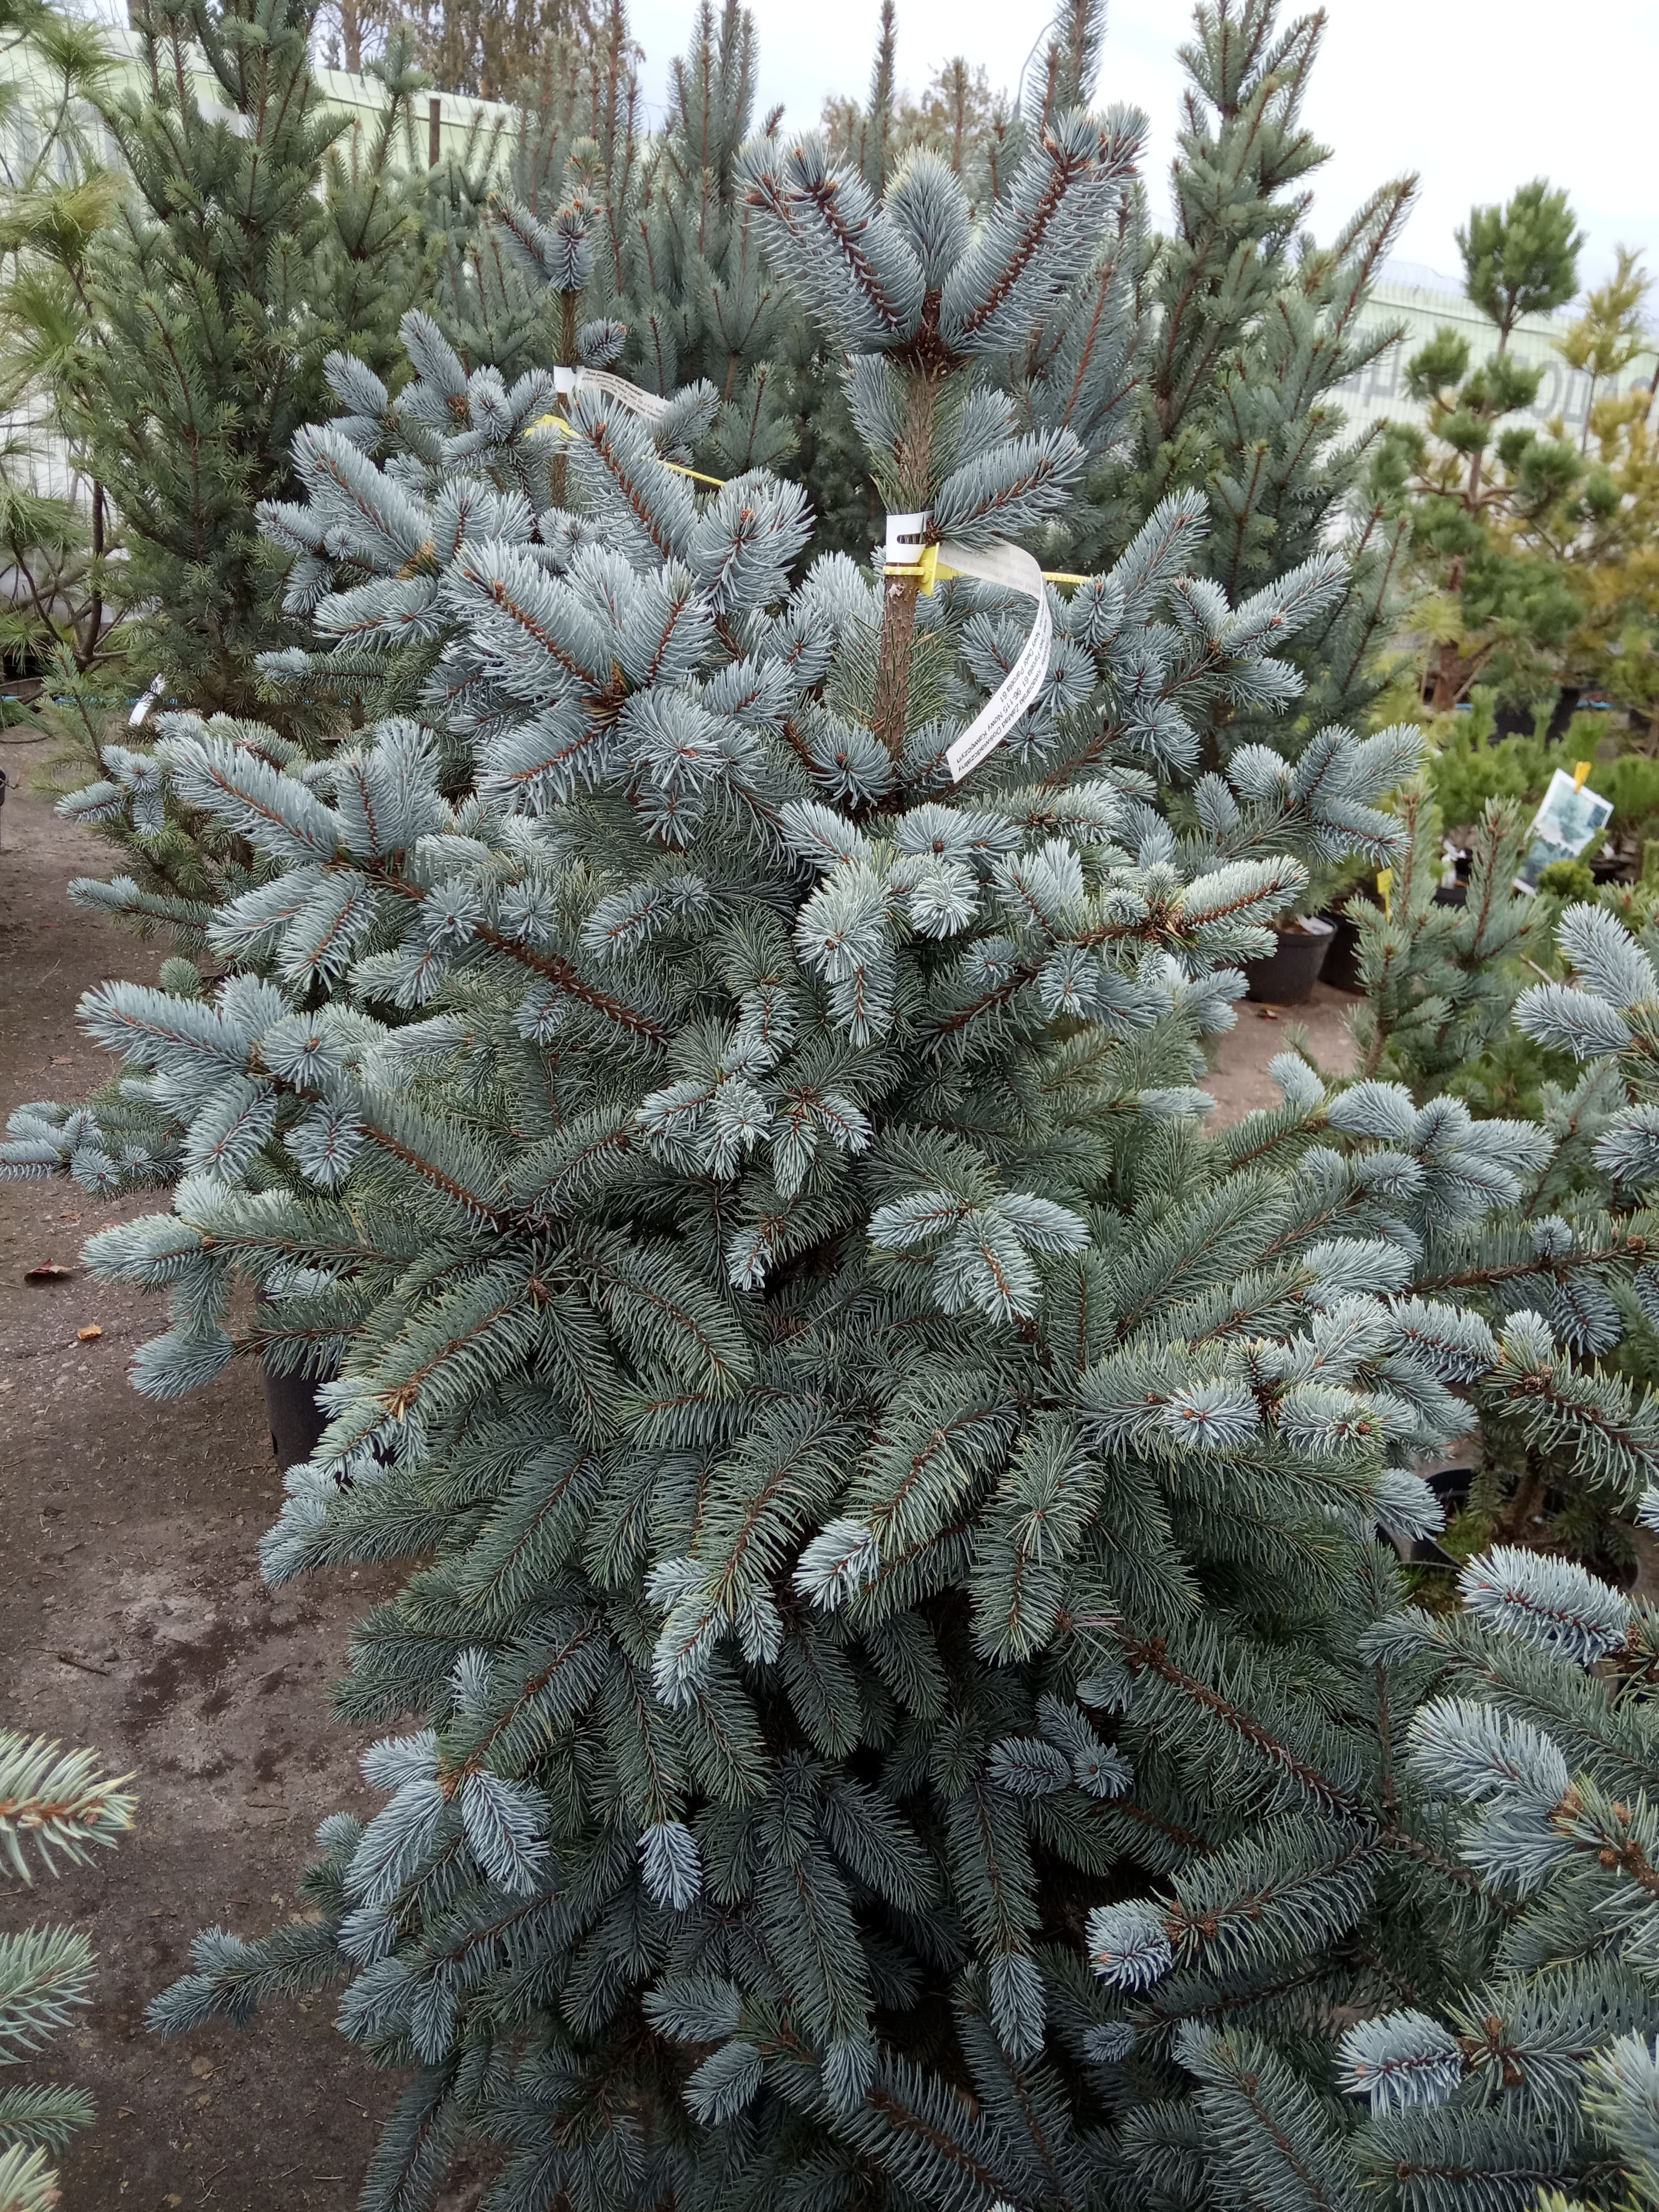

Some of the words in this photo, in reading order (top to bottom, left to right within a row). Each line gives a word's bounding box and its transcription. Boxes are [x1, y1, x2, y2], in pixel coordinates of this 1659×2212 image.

[1023, 648, 1034, 666] Dwór
[1007, 666, 1024, 692] Parcela
[1000, 691, 1008, 702] 61
[1003, 688, 1021, 714] 96-115
[987, 711, 1003, 732] Nowy
[1002, 703, 1020, 728] Zakład
[958, 726, 1002, 772] Doświadczalny
